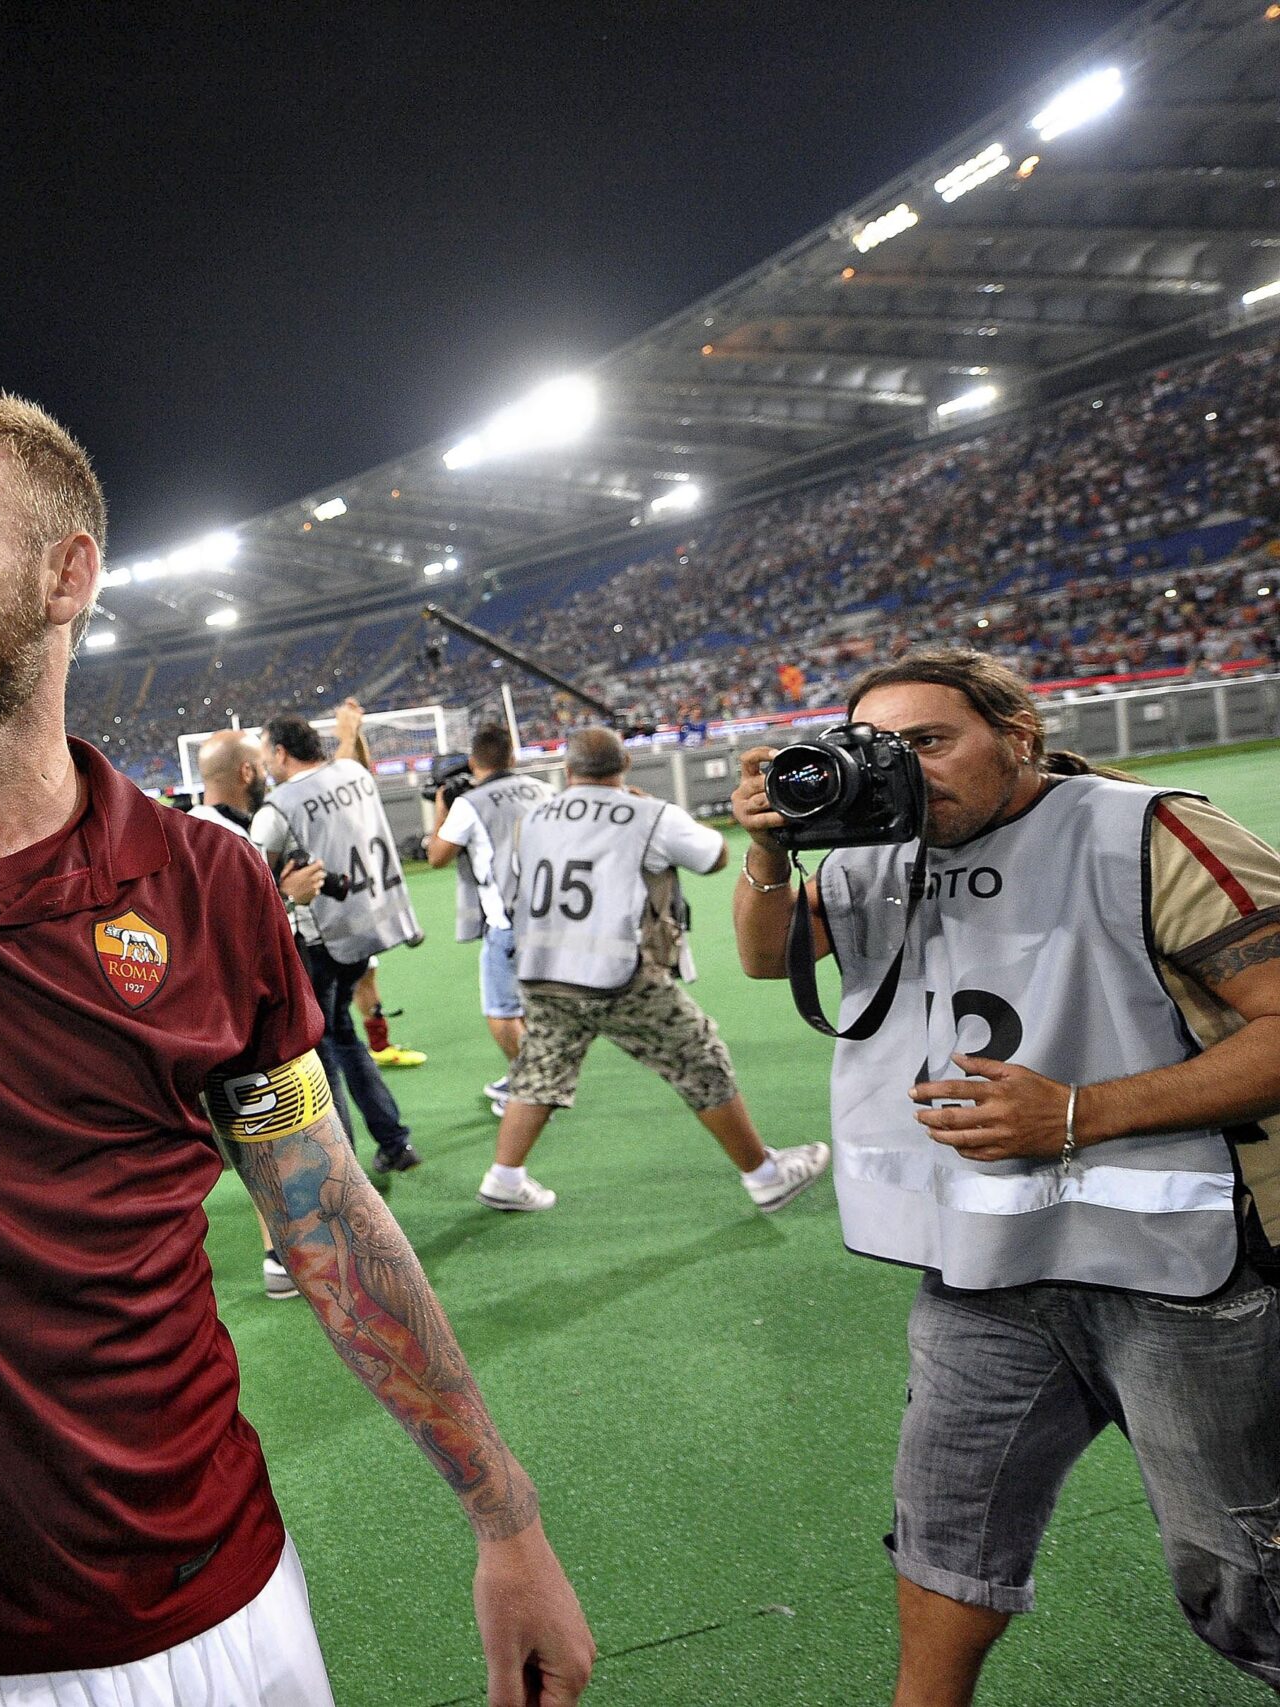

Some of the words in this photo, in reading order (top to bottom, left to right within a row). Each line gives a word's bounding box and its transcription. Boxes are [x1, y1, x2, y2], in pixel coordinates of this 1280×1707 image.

[349, 837, 401, 898] 42
[530, 859, 593, 920] 05
[108, 960, 160, 983] ROMA
[124, 982, 145, 994] 1927
[223, 1072, 277, 1116] C
